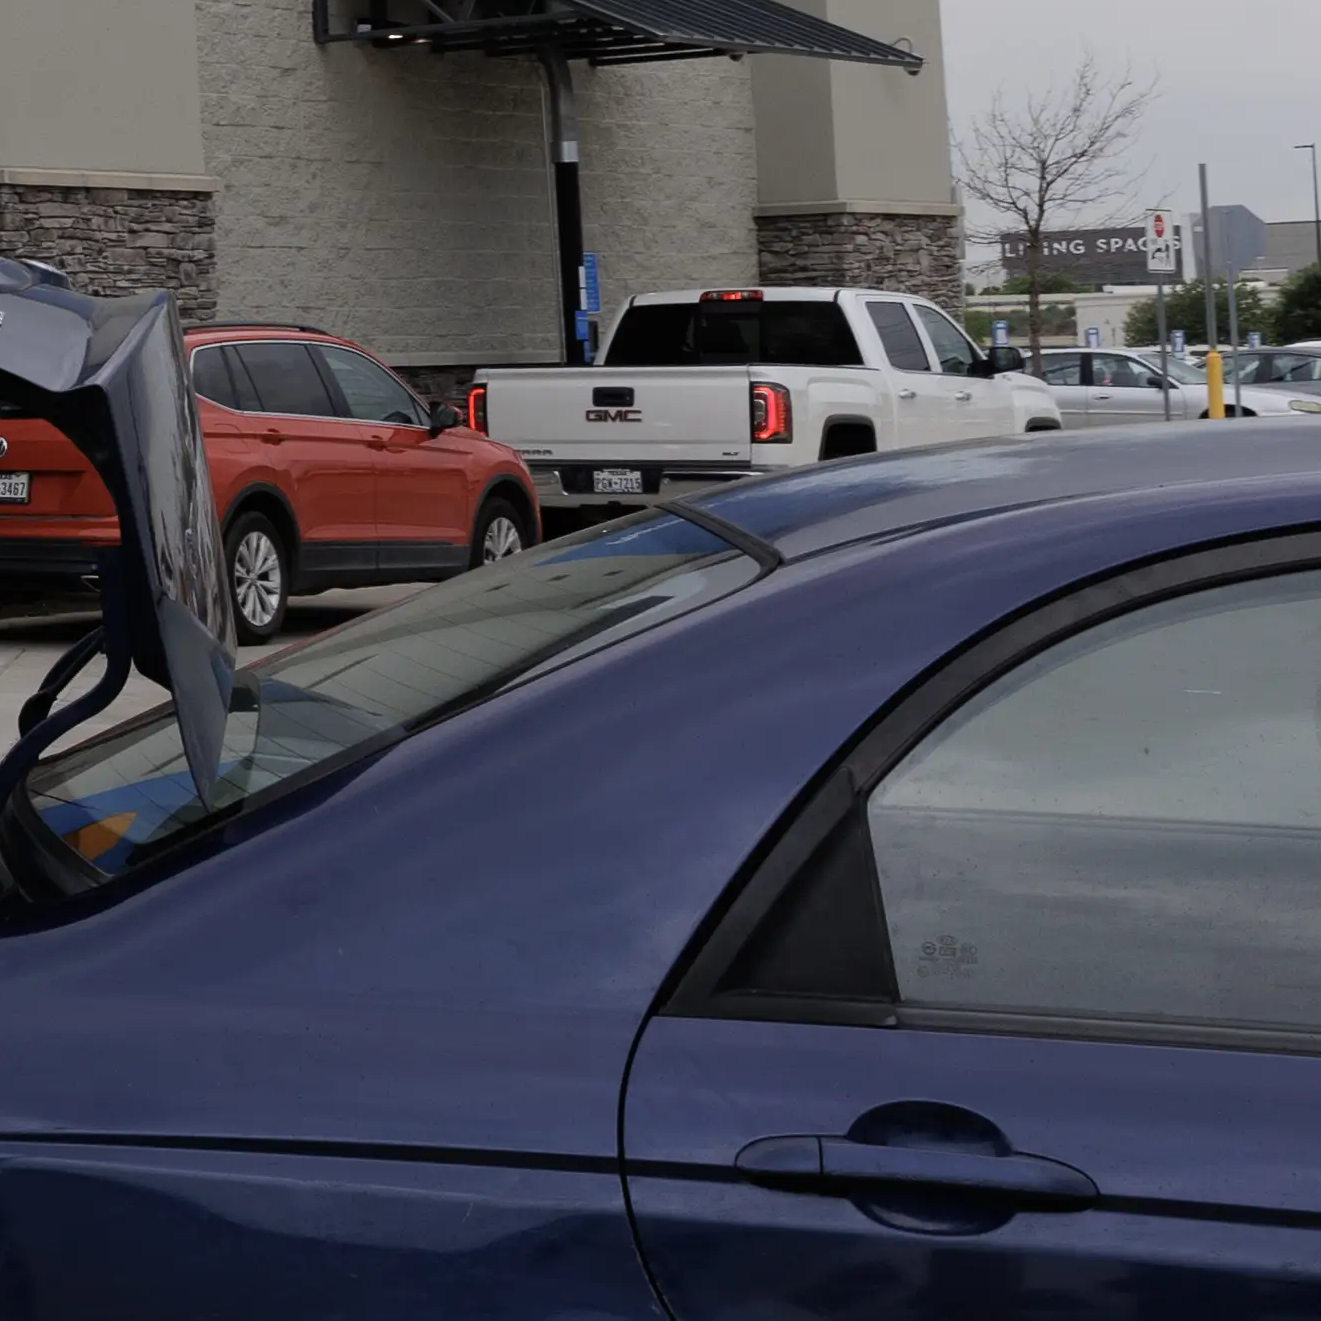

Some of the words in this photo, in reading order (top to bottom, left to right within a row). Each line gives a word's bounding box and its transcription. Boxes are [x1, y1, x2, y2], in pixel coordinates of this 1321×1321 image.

[1004, 239, 1086, 257] LIING
[1095, 235, 1181, 253] SPACS
[586, 410, 642, 422] GMC
